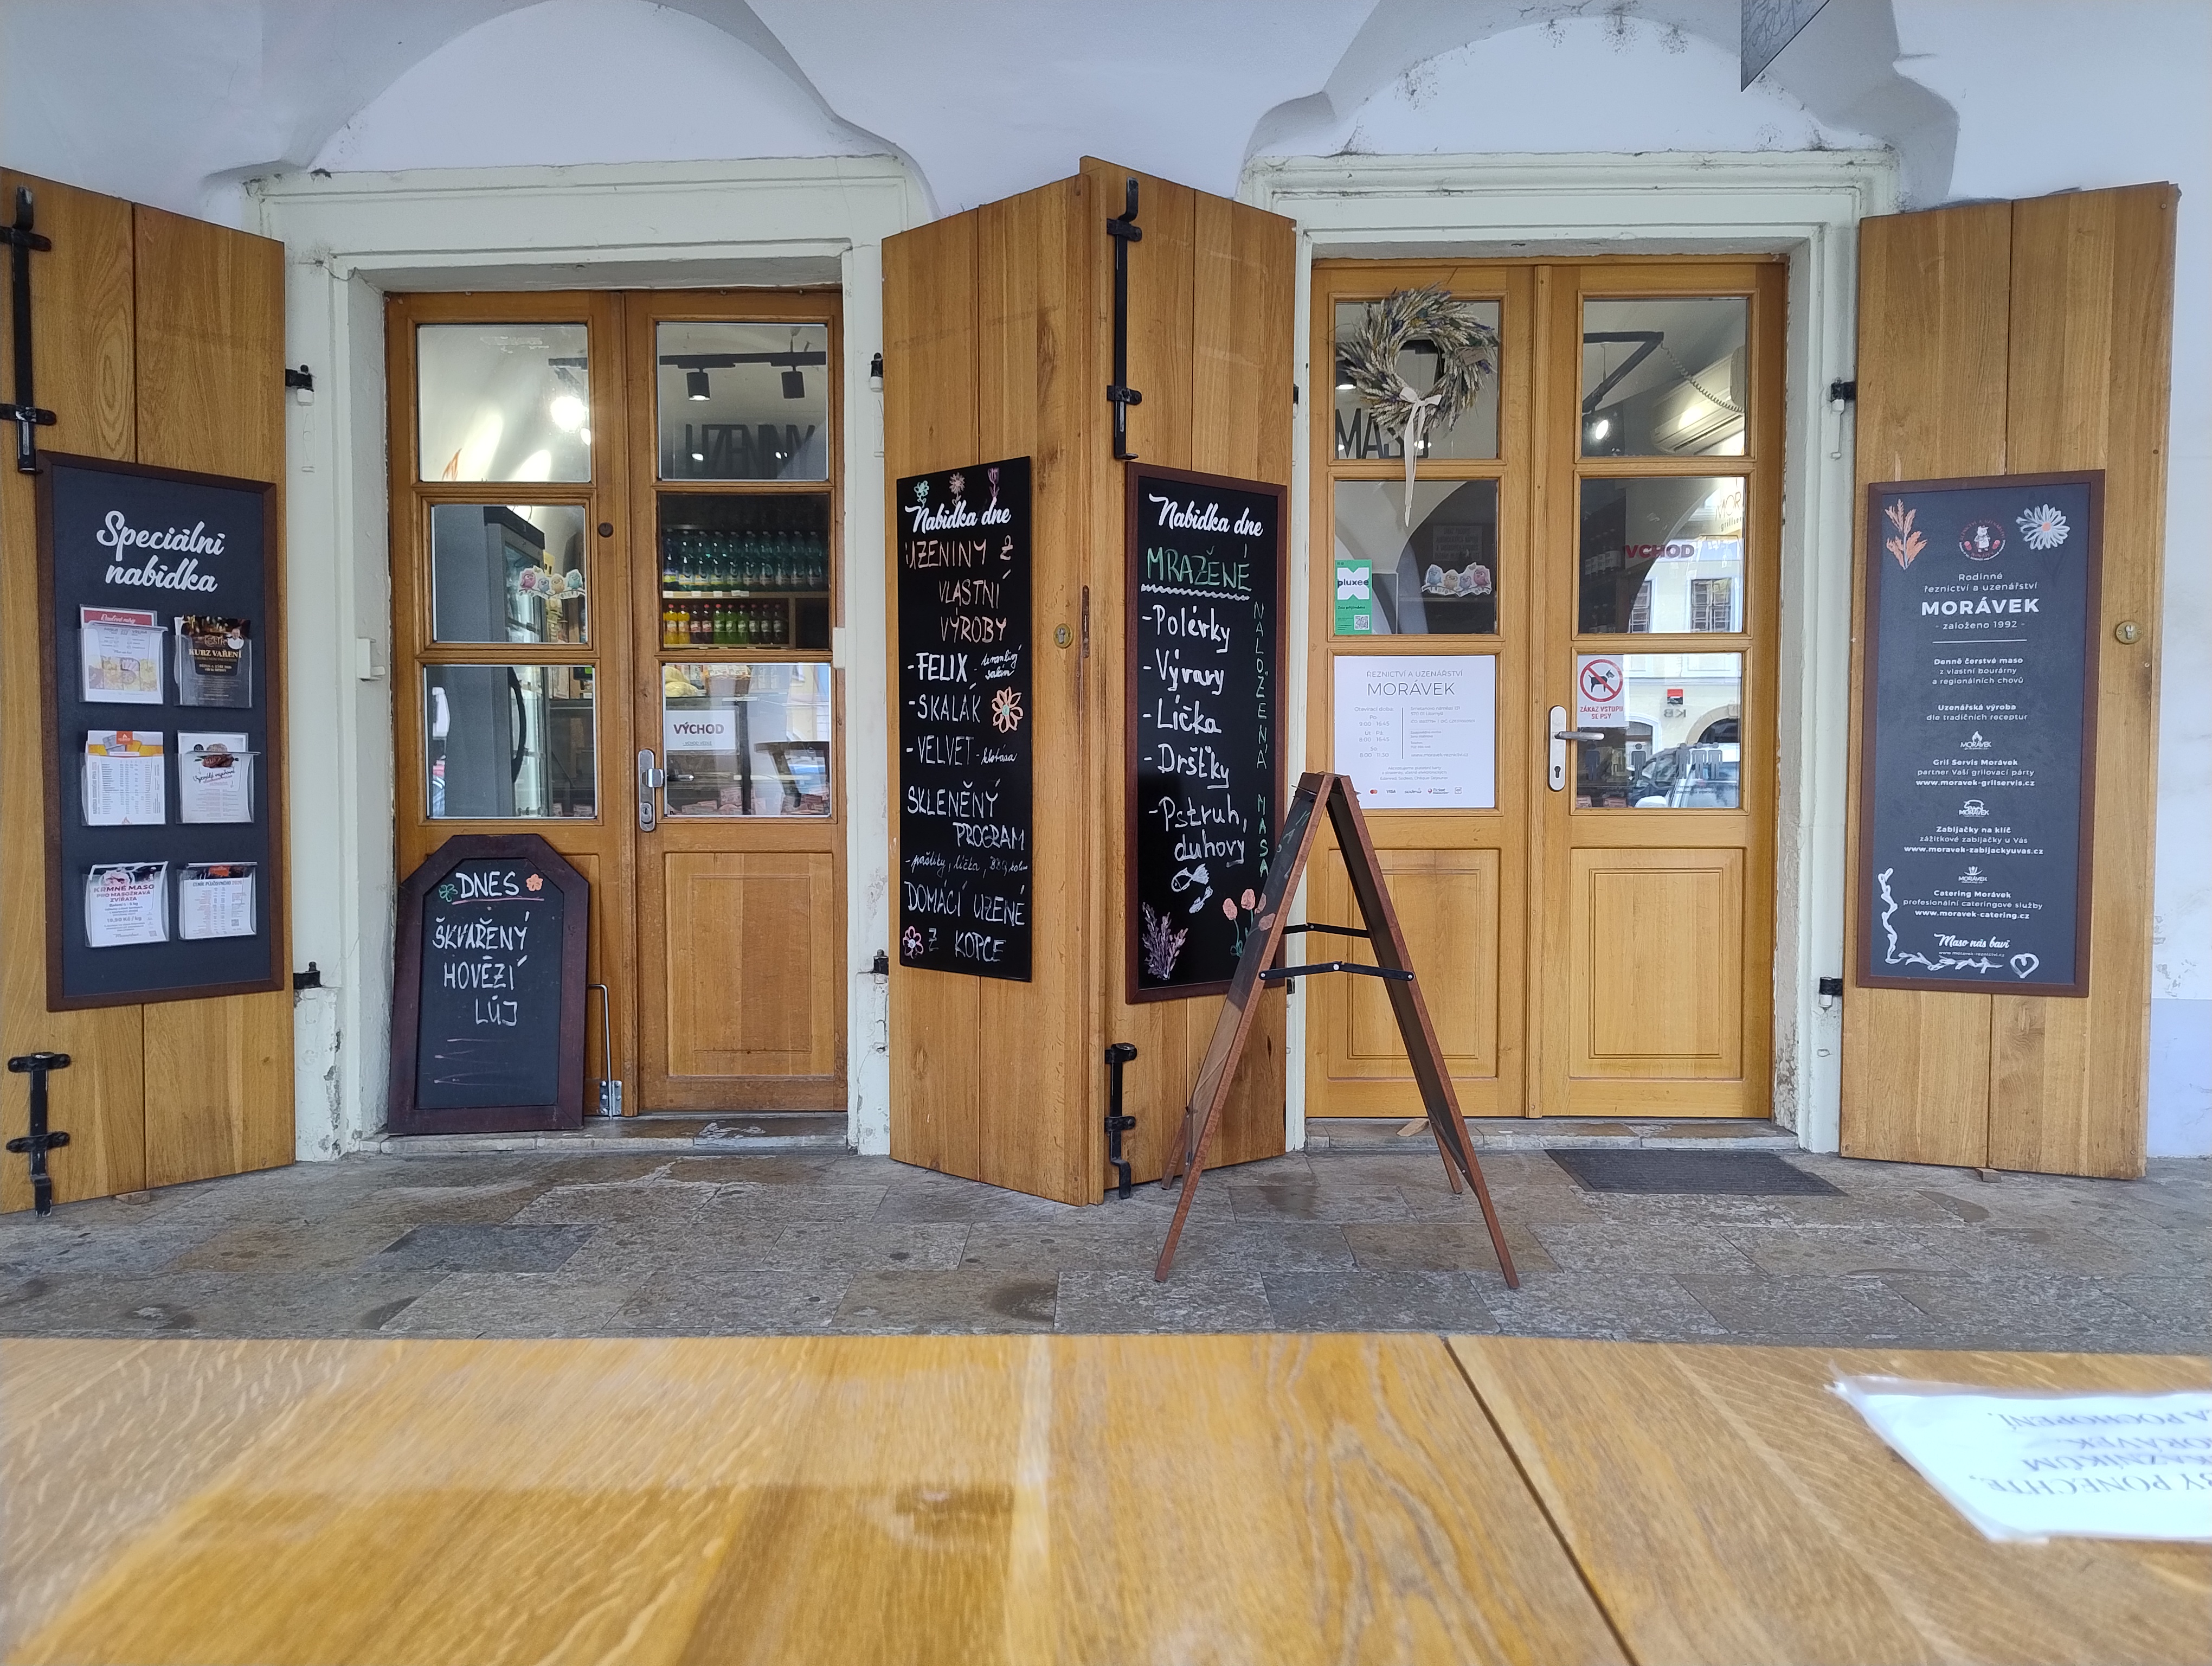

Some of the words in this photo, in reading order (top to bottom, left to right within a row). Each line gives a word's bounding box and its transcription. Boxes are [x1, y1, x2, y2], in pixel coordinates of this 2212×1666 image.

[905, 499, 978, 534] Nabídka
[981, 497, 1012, 526] dne
[1149, 493, 1231, 529] Nabídka
[1233, 507, 1264, 537] dne
[97, 510, 226, 561] Speciální
[1626, 544, 1695, 559] VCHOD
[105, 555, 218, 592] nabídka
[1147, 543, 1252, 591] MRAŽENÉ
[1337, 579, 1369, 589] pluxee
[1958, 573, 2003, 581] Rodinné
[939, 569, 1011, 610] VLASTNÍ
[1924, 584, 1970, 593] řeznictví
[1983, 582, 2039, 591] uzenářství
[1921, 597, 2040, 616] MORÁVEK
[941, 607, 1007, 643] VÝROBY
[1943, 621, 1990, 630] založeno
[1994, 620, 2017, 629] 1992
[189, 649, 211, 657] KURZ
[212, 649, 242, 658] VAŘENÍ
[1367, 670, 1406, 678] ŘEZNICTVÍ
[1415, 669, 1463, 677] UZENÁŘSTVÍ
[1978, 667, 2017, 675] bourárny
[1368, 680, 1455, 696] MORÁVEK
[1940, 677, 1995, 685] regionálních
[673, 721, 724, 735] VÝCHOD
[1972, 768, 2009, 777] grilovací
[2011, 768, 2035, 777] párty
[1915, 779, 2035, 787] www.moravek-grilservis.cz
[907, 778, 1001, 818] SKLENĚNÝ
[953, 822, 1025, 851] PROGRAM
[1257, 794, 1269, 878] MASA
[1936, 825, 1979, 834] Zabijačky
[1962, 836, 2002, 844] zabijačky
[1904, 845, 2044, 855] www.moravek-zabijackyuvas.cz
[93, 885, 126, 893] KRMNÉ
[455, 870, 520, 899] DNES
[1933, 889, 1971, 899] Catering
[1974, 890, 2011, 899] Morávek
[904, 879, 968, 917] DOMÁCÍ
[974, 885, 1025, 926] UZENÉ
[1903, 899, 1959, 907] profesionální
[1962, 901, 2012, 909] cateringové
[2015, 902, 2043, 910] služby
[1914, 909, 2030, 919] www.moravek-catering.cz
[433, 911, 530, 951] ŠKVAŘENÝ
[955, 930, 1006, 962] KOPCE
[1933, 933, 1969, 948] Maso
[1970, 939, 1986, 948] nás
[1989, 936, 2011, 949] baví
[443, 955, 528, 990] HOVĚZÍ
